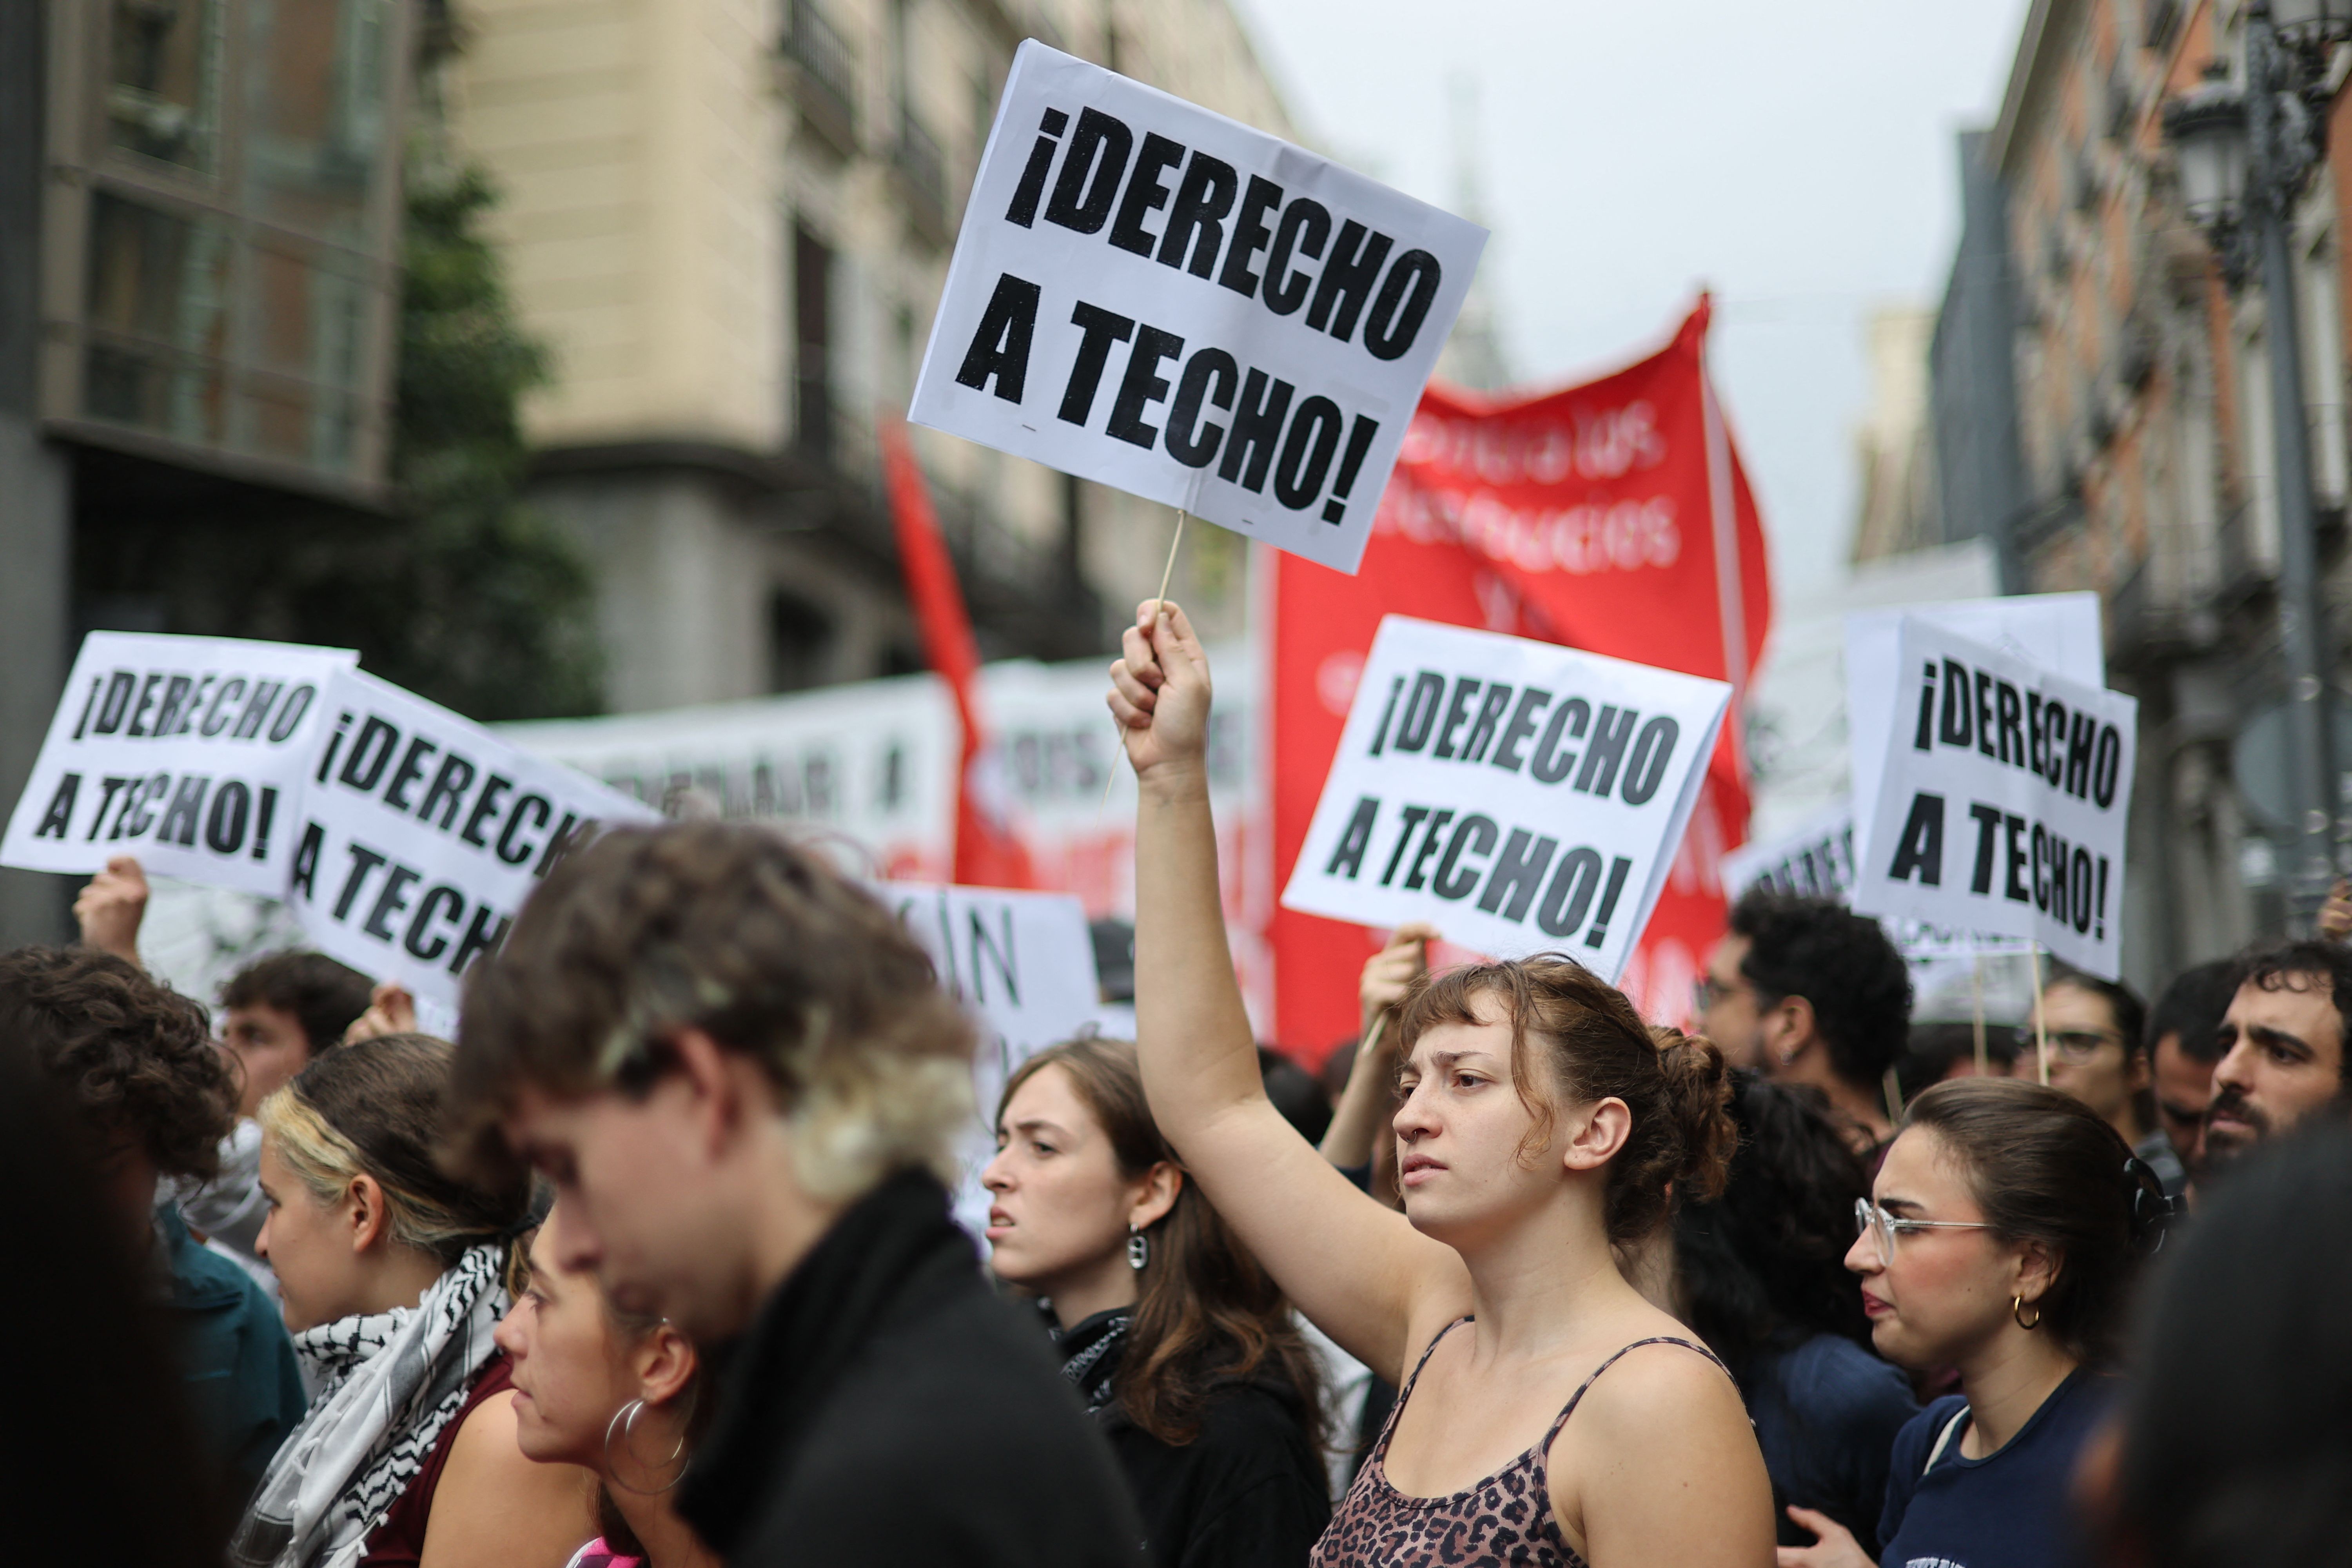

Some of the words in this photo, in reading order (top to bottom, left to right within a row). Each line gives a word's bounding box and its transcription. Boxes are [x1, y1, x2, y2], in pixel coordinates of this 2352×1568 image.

[1005, 106, 1441, 361] ¡DERECHO
[955, 272, 1041, 405] A
[1057, 300, 1379, 527] TECHO!
[72, 670, 317, 743] ¡DERECHO
[1370, 672, 1679, 806] ¡DERECHO
[1913, 657, 2122, 812] ¡DERECHO
[34, 773, 82, 840] A
[86, 774, 279, 860] TECHO!
[315, 711, 596, 883] ¡DERECH
[1326, 798, 1379, 879] A
[1380, 806, 1632, 949] TECHO!
[1887, 791, 1945, 888] A
[1968, 802, 2110, 943] TECHO!
[291, 821, 325, 900] A
[333, 843, 513, 975] TECH
